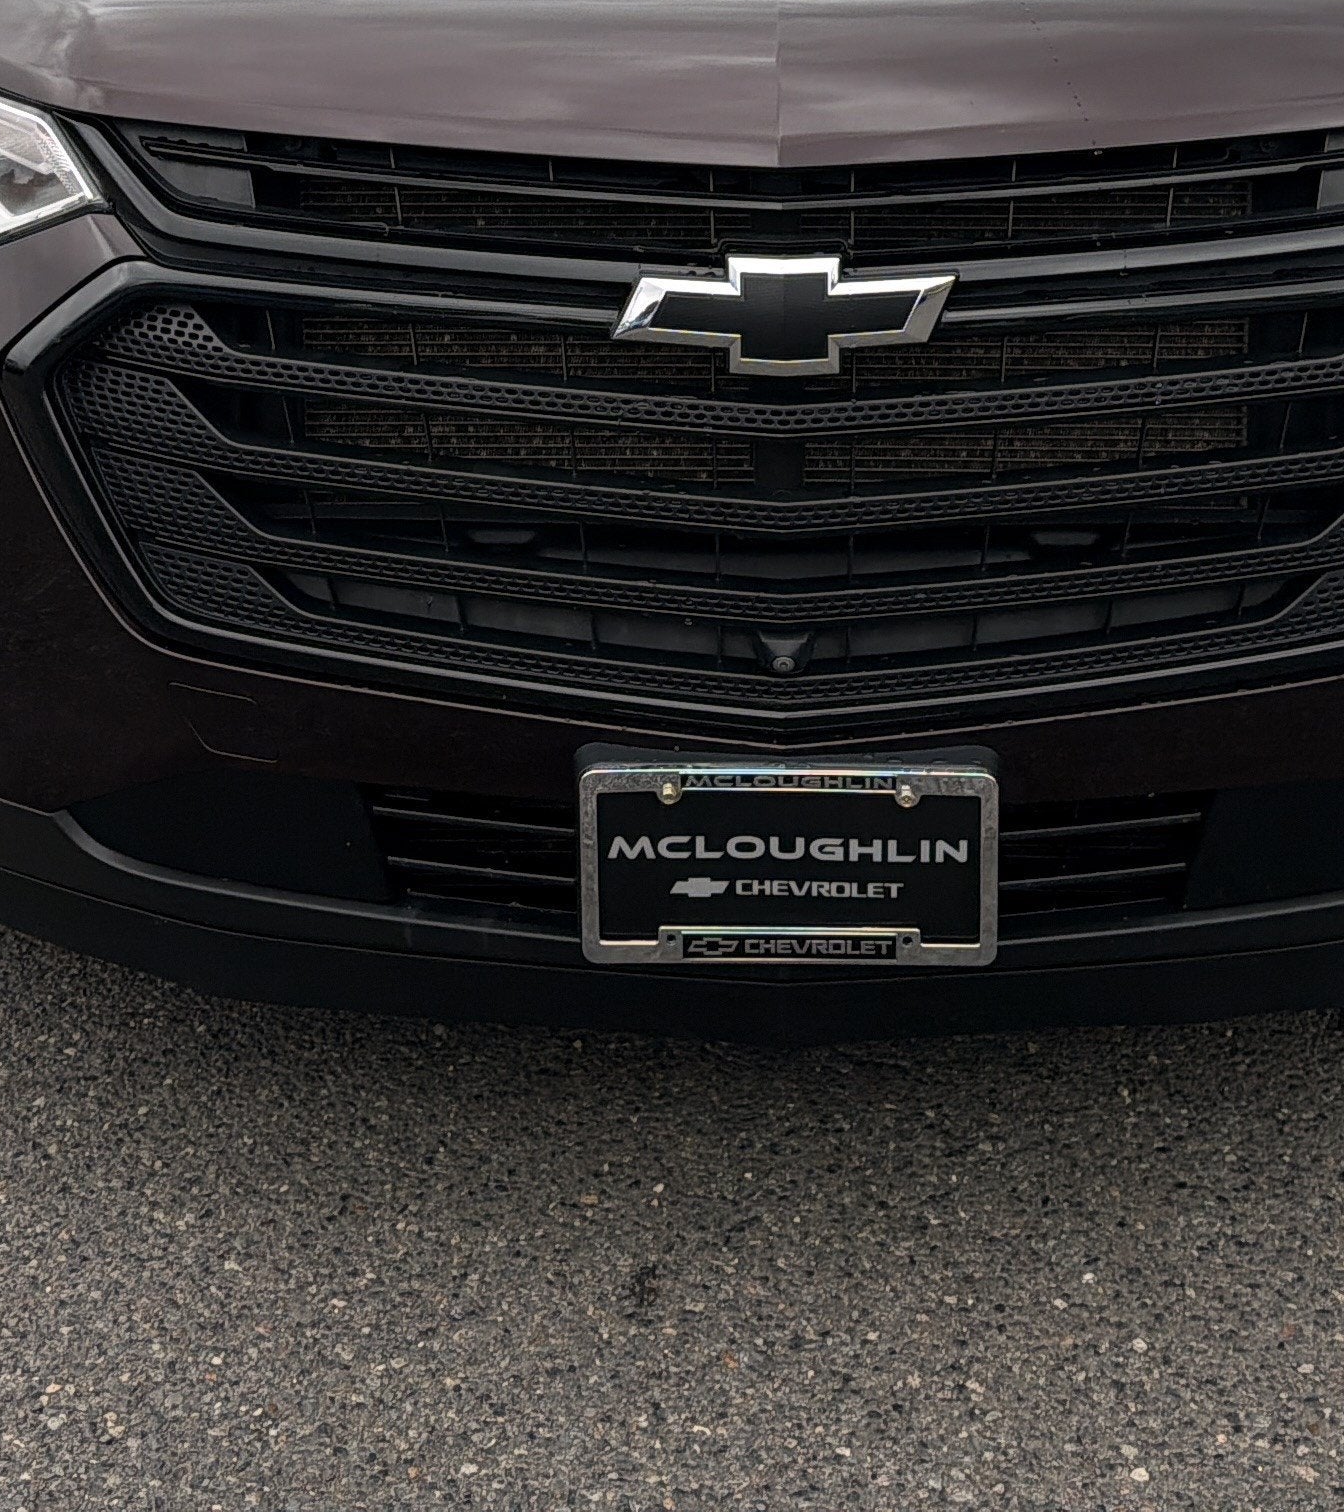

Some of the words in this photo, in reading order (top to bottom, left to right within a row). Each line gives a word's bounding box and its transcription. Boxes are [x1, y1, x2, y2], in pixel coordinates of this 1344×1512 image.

[684, 774, 895, 789] MCLOUGHLIN
[607, 835, 969, 863] MCLOUGHLIN
[735, 879, 904, 899] CHEVROLET
[744, 939, 893, 955] CHEVROLET
